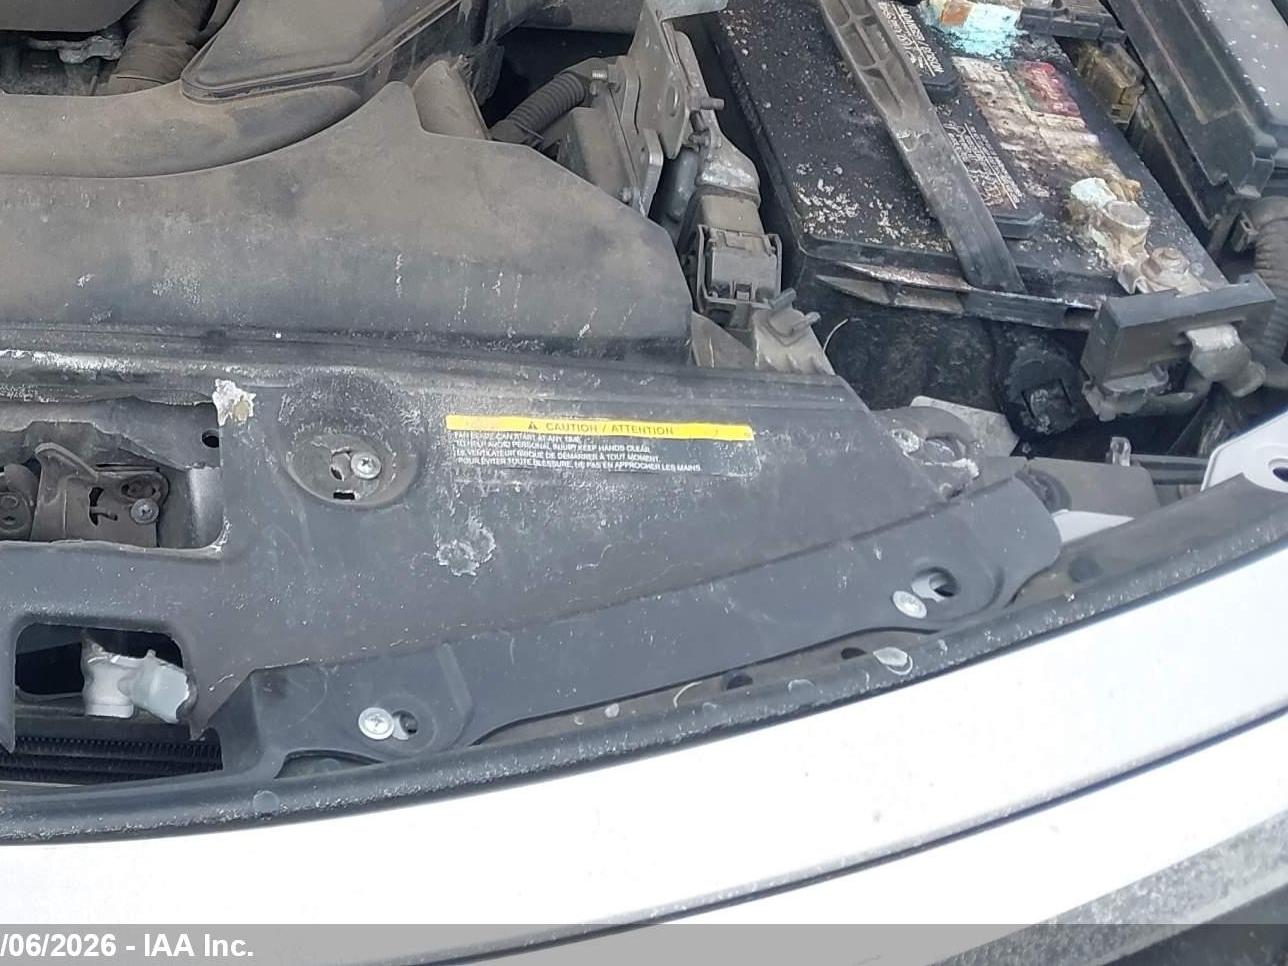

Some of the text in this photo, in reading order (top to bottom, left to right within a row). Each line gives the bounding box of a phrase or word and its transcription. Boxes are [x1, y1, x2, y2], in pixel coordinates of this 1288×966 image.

[546, 422, 597, 432] CAUTION
[611, 424, 674, 435] ATTENTION
[614, 462, 660, 470] APPROCHER
